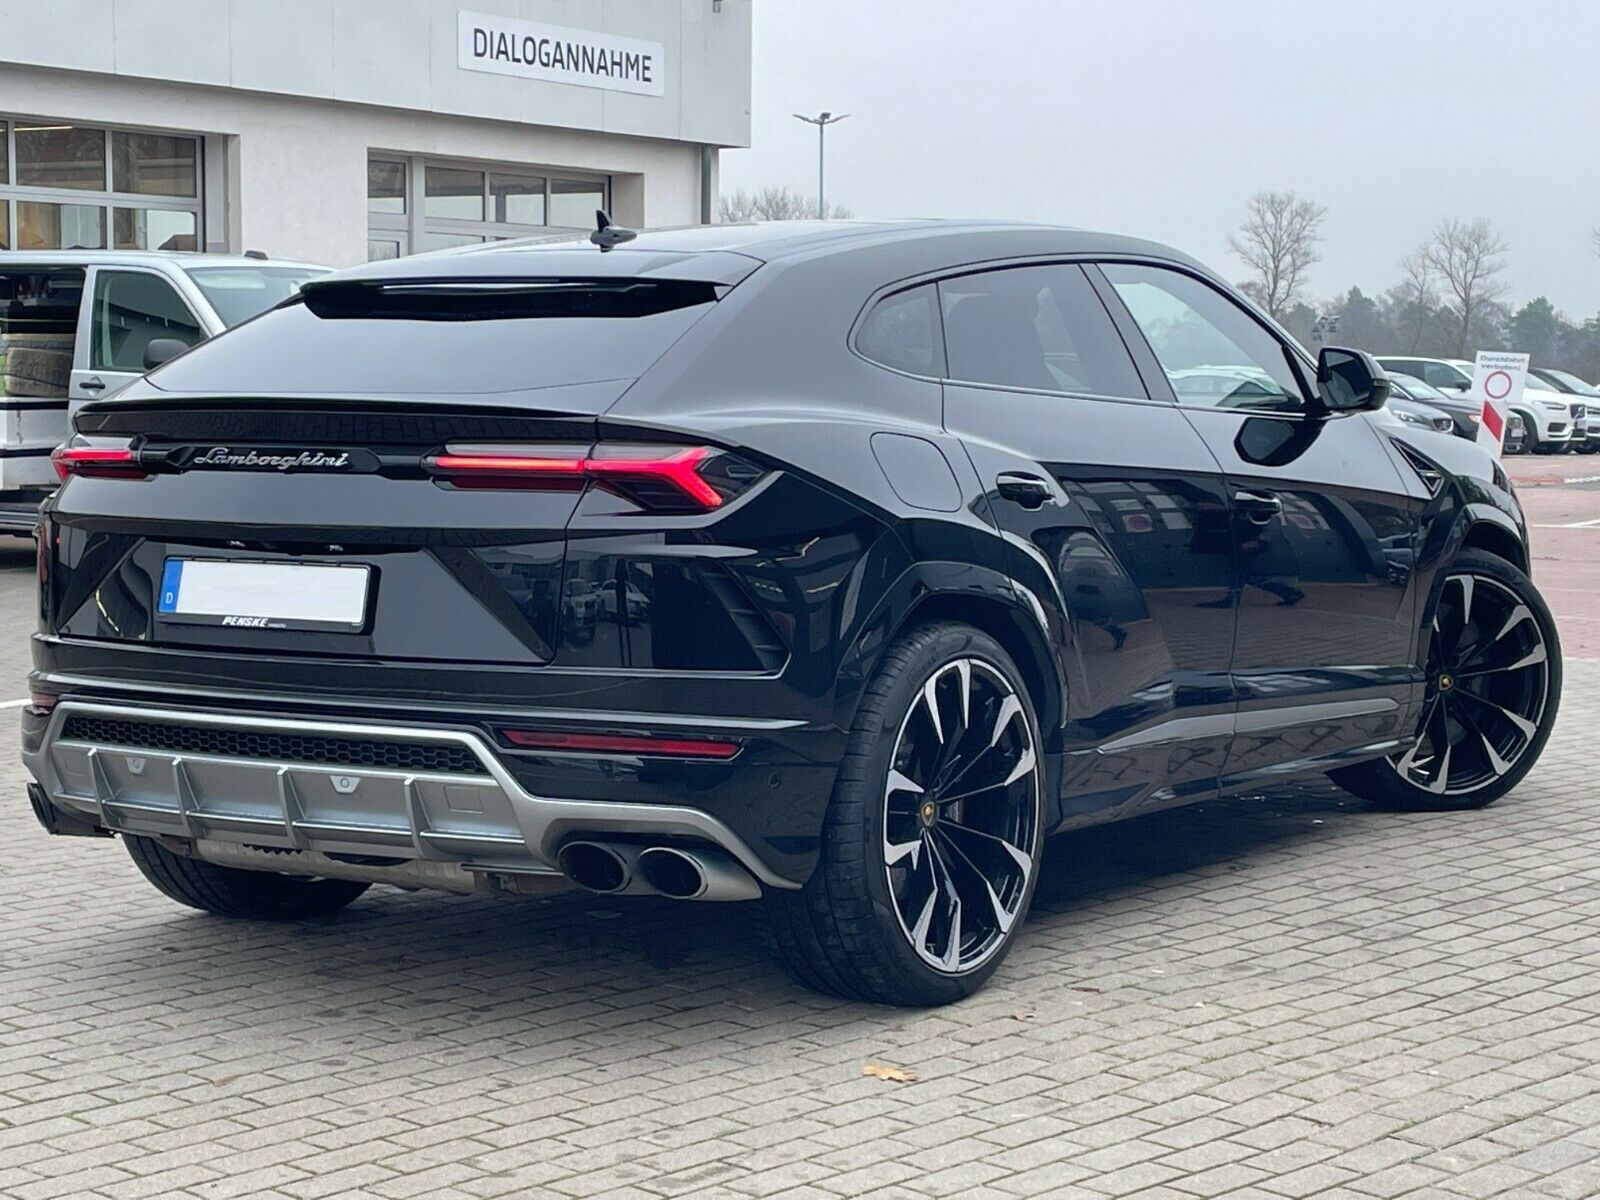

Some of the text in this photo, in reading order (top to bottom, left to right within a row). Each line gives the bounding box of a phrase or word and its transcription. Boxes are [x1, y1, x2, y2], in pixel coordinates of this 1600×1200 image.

[473, 28, 652, 82] DIALOGANNAHME
[194, 447, 349, 470] Lamborghini
[165, 592, 174, 604] D
[222, 616, 269, 627] PENSKE
